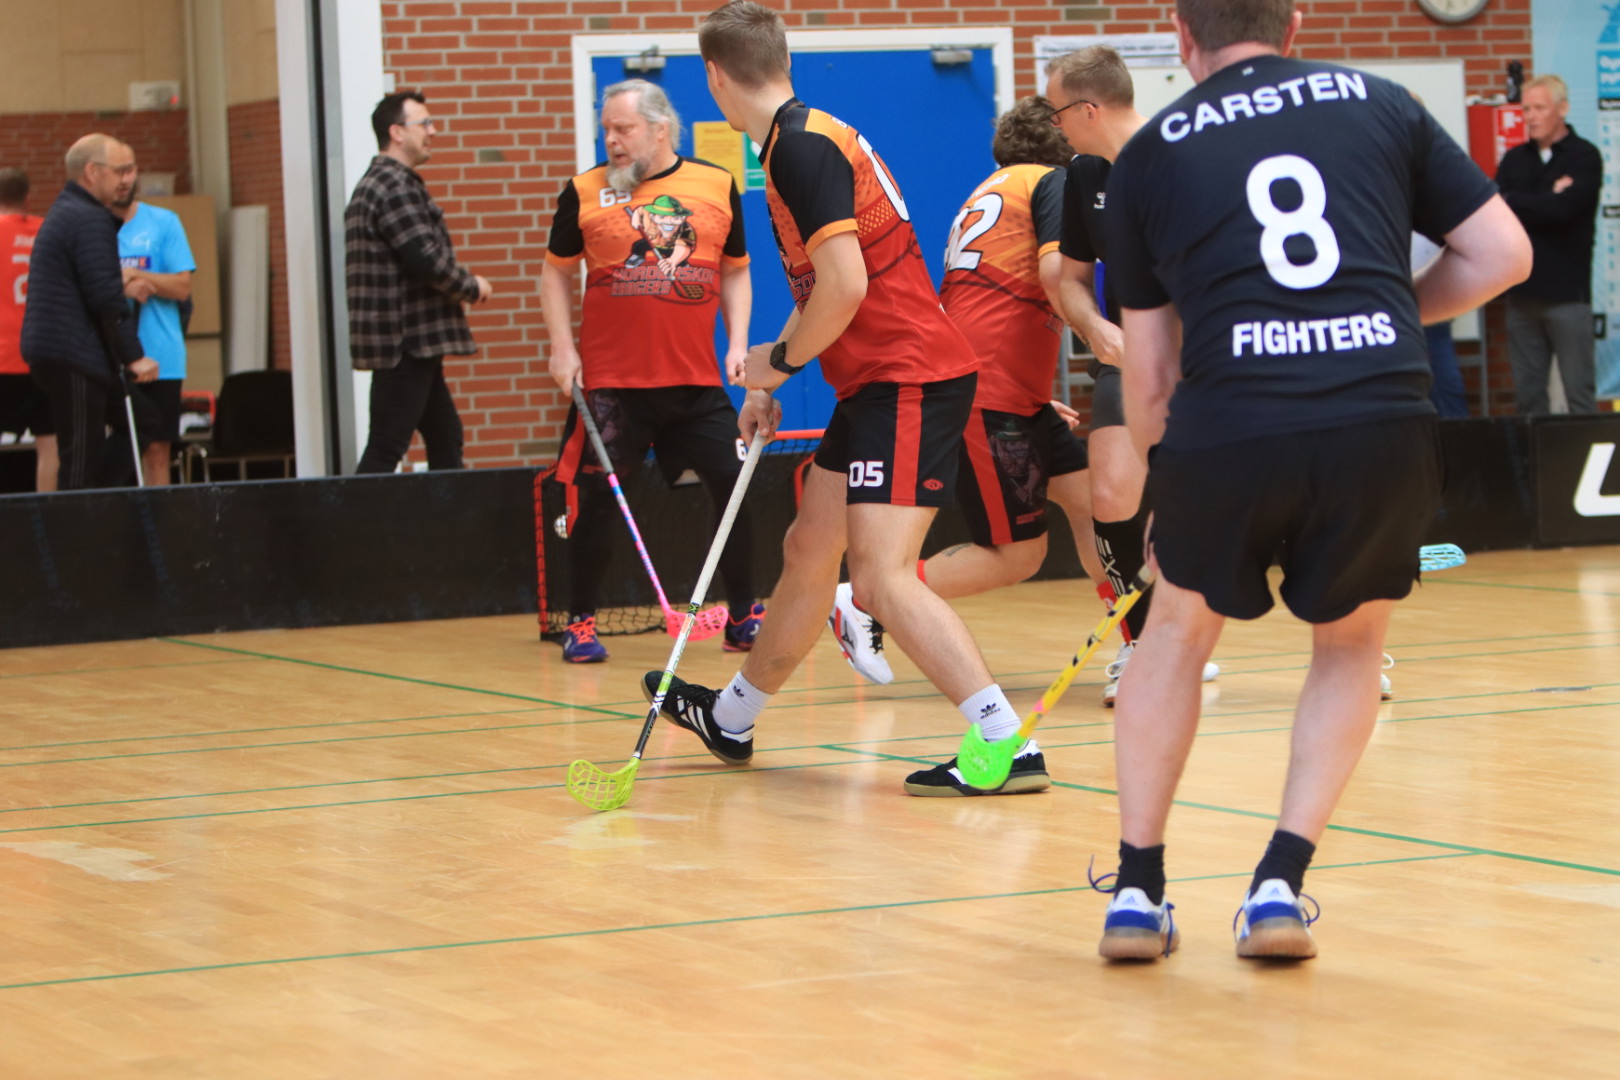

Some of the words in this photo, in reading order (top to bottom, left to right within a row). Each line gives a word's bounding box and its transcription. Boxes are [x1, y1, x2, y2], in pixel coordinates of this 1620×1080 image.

[1160, 72, 1367, 143] CARSTEN
[1246, 154, 1341, 290] 8
[1232, 312, 1397, 357] FIGHTERS
[848, 460, 884, 488] 05
